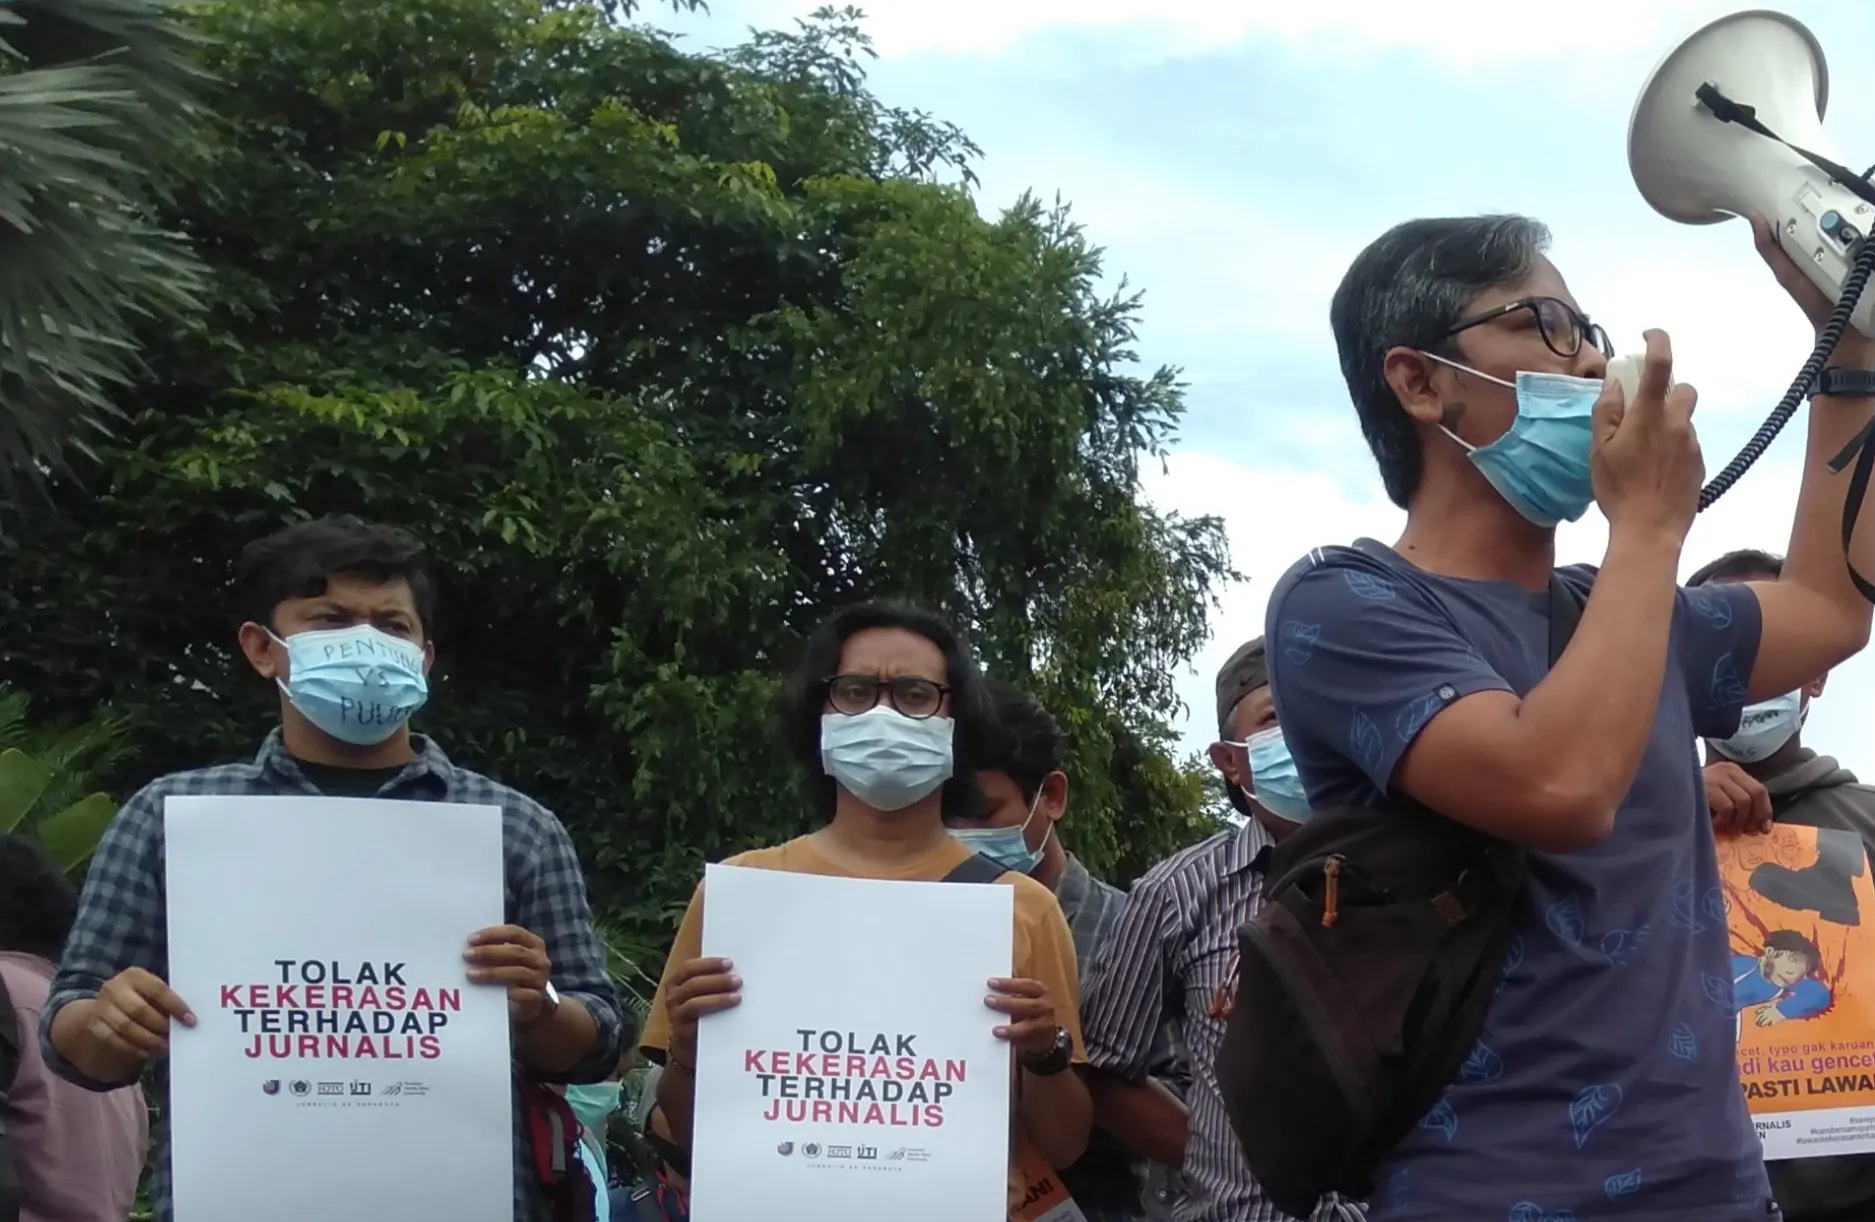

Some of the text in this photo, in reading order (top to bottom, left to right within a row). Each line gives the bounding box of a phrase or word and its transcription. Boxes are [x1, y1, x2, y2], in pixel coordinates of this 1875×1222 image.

[275, 960, 407, 985] TOLAK
[221, 984, 460, 1011] KEKERASAN
[234, 1009, 448, 1034] TERHADAP
[244, 1034, 441, 1059] JURNALIS
[797, 1029, 917, 1057] TOLAK
[1769, 1045, 1798, 1056] typo
[1803, 1042, 1826, 1055] gak
[745, 1049, 966, 1082] KEKERASAN
[1768, 1057, 1804, 1073] kau
[756, 1074, 953, 1103] TERHADAP
[763, 1098, 944, 1127] JURNALIS
[1754, 1120, 1791, 1130] RNALIS
